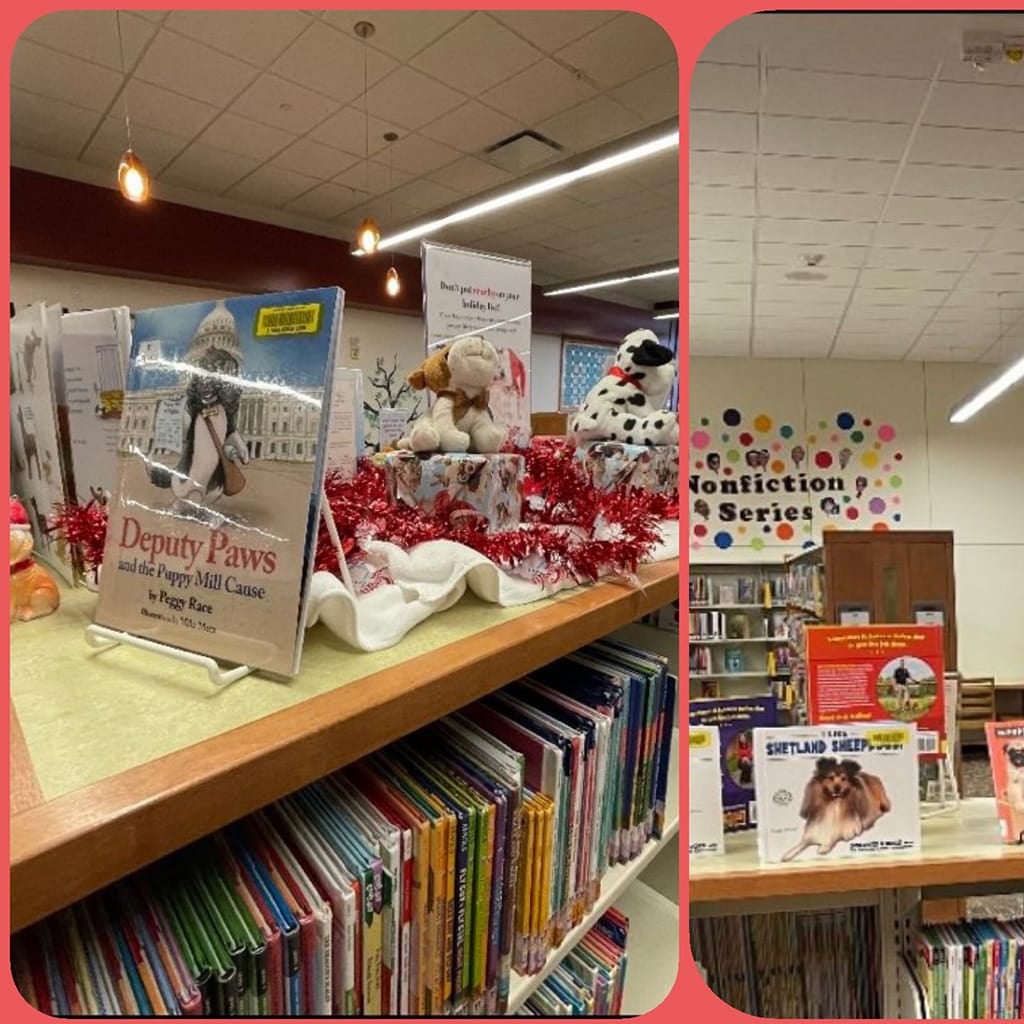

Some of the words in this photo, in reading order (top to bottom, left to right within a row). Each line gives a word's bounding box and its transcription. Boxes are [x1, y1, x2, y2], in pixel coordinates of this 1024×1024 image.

[689, 473, 845, 495] Nonfiction
[718, 502, 814, 522] Series
[119, 517, 205, 571] Deputy
[205, 529, 278, 574] Paws
[118, 558, 137, 574] and
[138, 561, 155, 577] the
[156, 563, 194, 590] Puppy
[195, 570, 222, 592] Mill
[225, 576, 266, 600] Cause
[159, 590, 187, 611] Peggy
[188, 596, 213, 614] Race
[766, 739, 828, 756] SHETLAND
